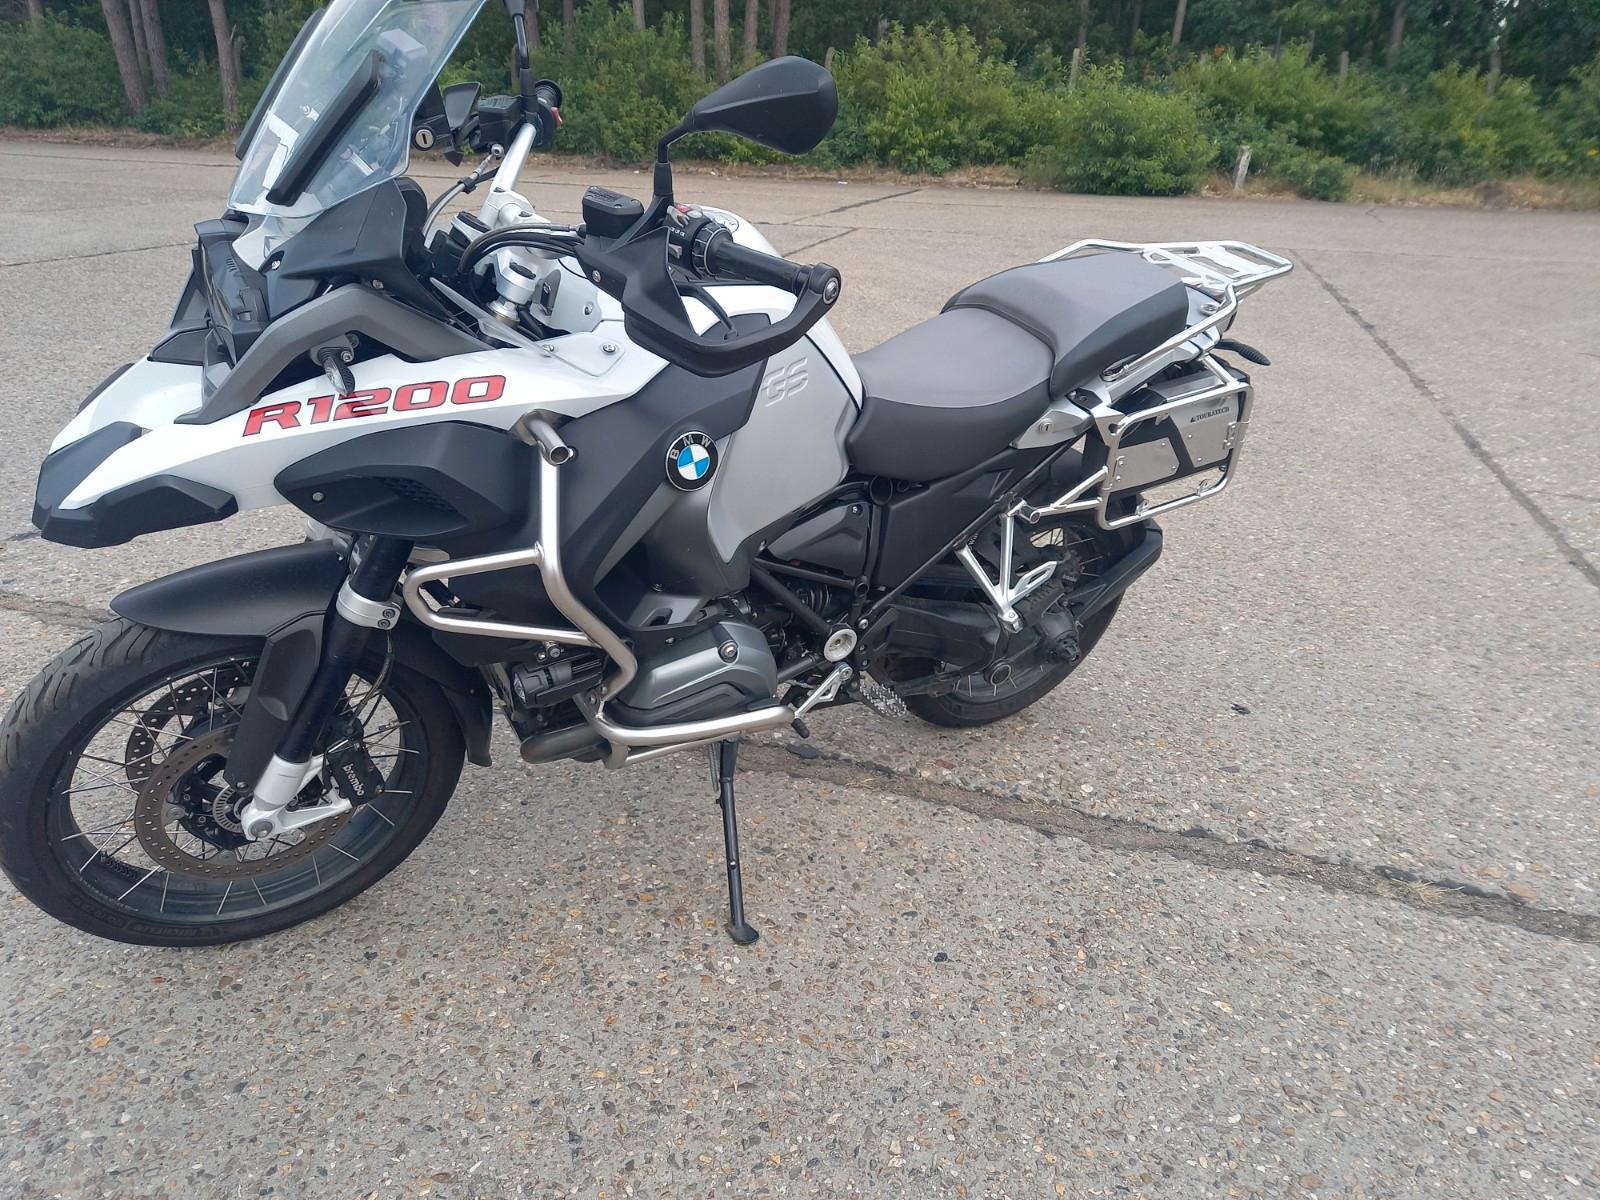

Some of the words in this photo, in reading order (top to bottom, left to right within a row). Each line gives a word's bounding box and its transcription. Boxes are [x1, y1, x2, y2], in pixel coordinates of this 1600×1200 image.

[760, 356, 809, 408] GS
[242, 374, 506, 437] R1200
[669, 435, 712, 460] BMW
[343, 763, 365, 796] brembo
